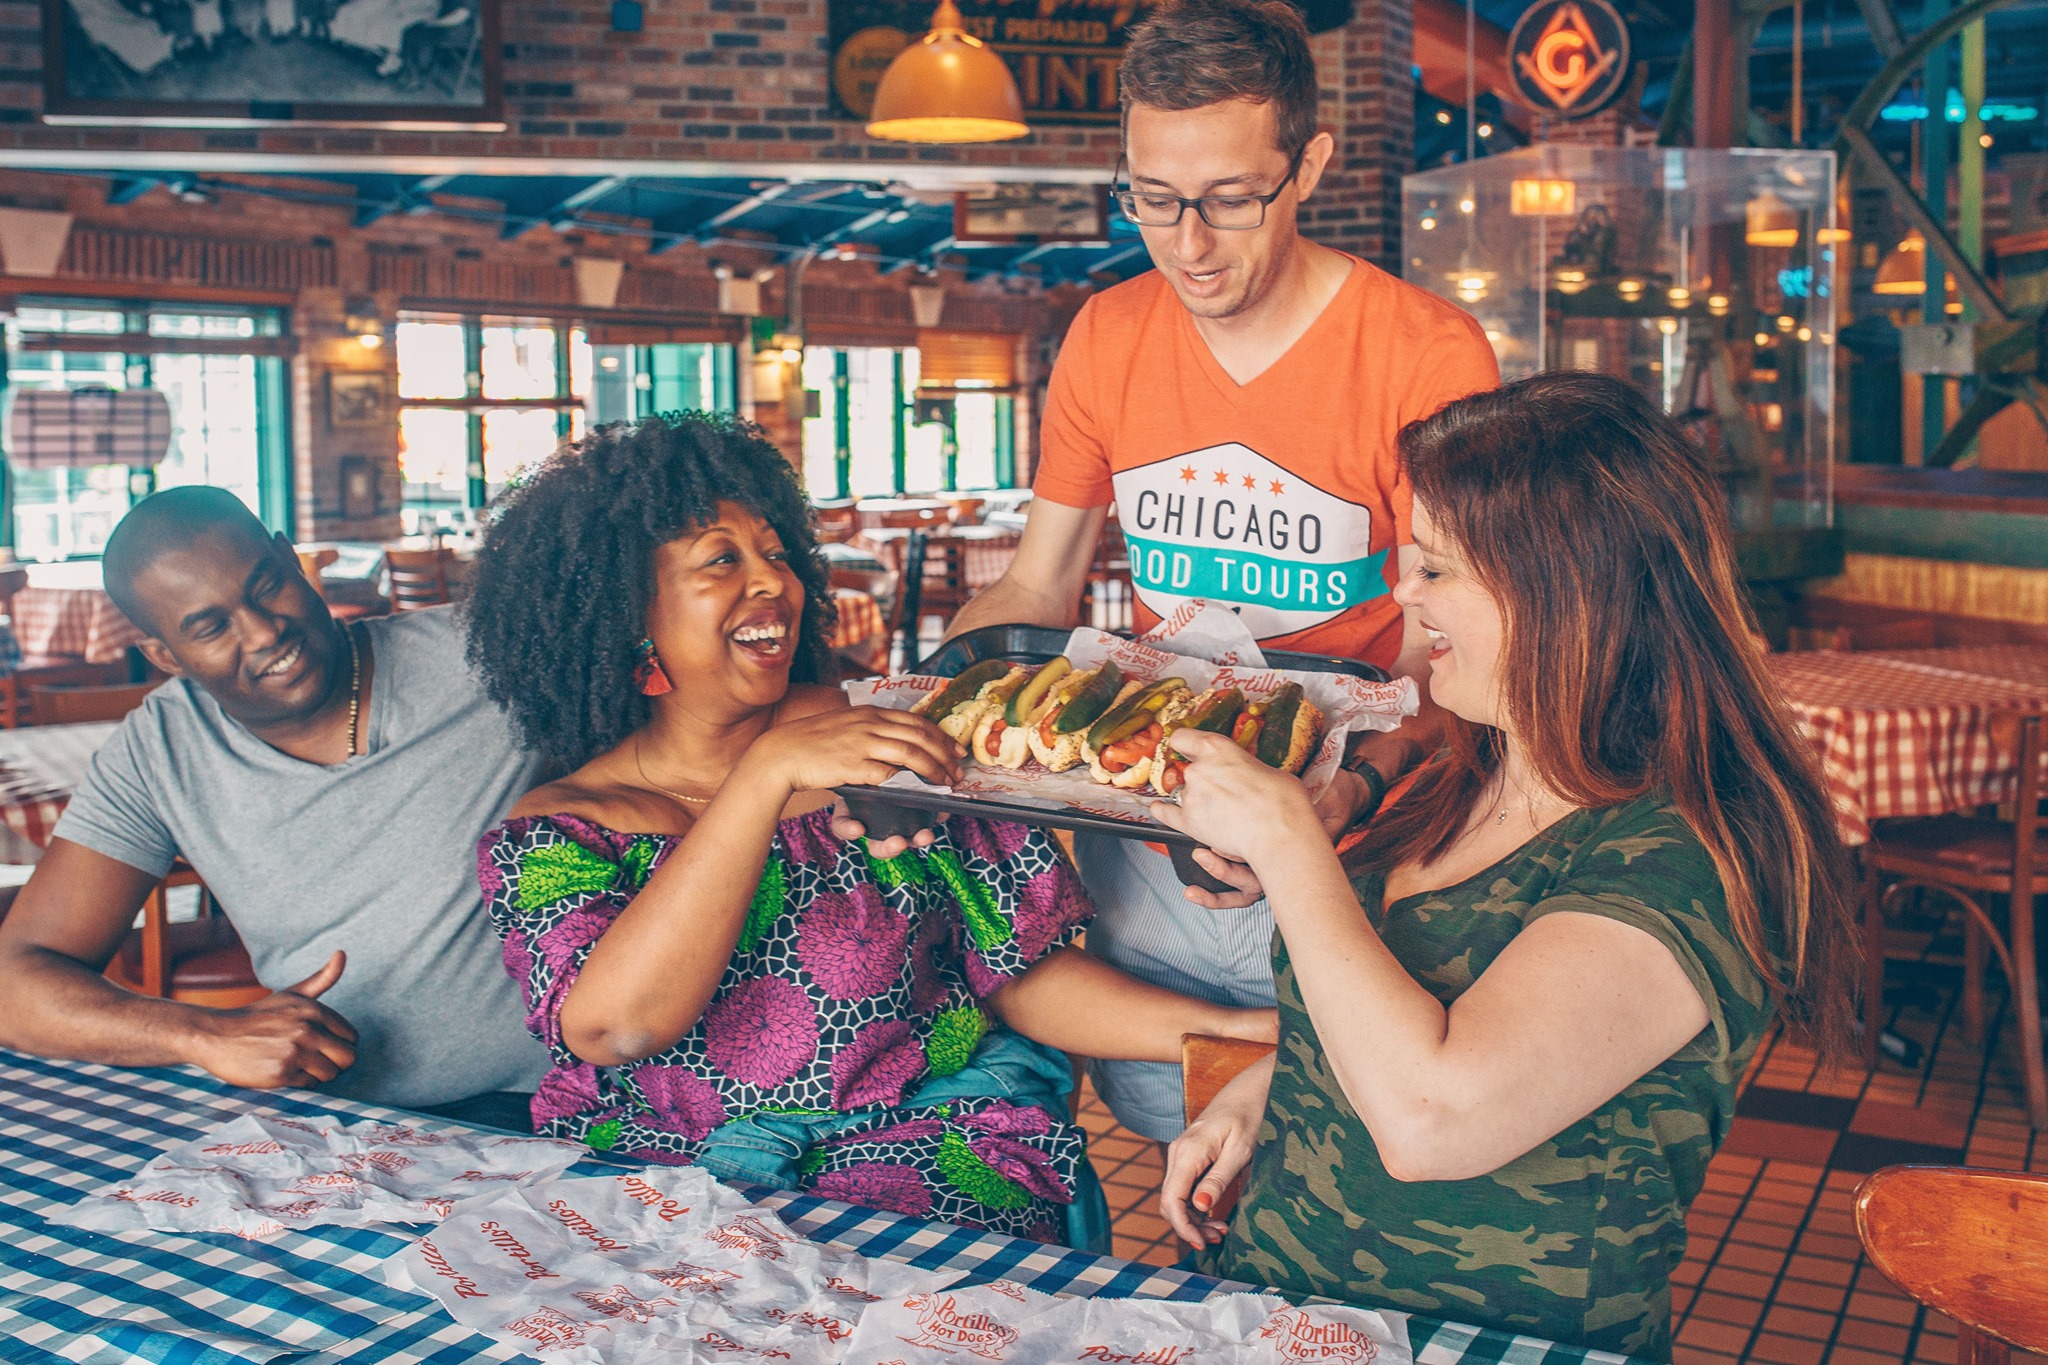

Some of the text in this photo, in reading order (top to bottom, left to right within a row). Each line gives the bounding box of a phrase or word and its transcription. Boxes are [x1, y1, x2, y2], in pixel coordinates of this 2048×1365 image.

[963, 16, 995, 39] EST
[1536, 29, 1584, 88] G
[1022, 55, 1121, 108] INT
[1136, 490, 1322, 554] CHICAGO
[1124, 543, 1347, 606] OOD TOURS
[1114, 649, 1158, 669] HOT DOGS
[872, 676, 937, 695] Portill
[1211, 668, 1288, 694] Portillo'
[1375, 690, 1397, 702] DOGS
[480, 1221, 560, 1280] Portillo's
[530, 1317, 576, 1341] HOT DOGS
[928, 1320, 993, 1343] HOT DOGS
[1289, 1340, 1357, 1358] HOT DOGS
